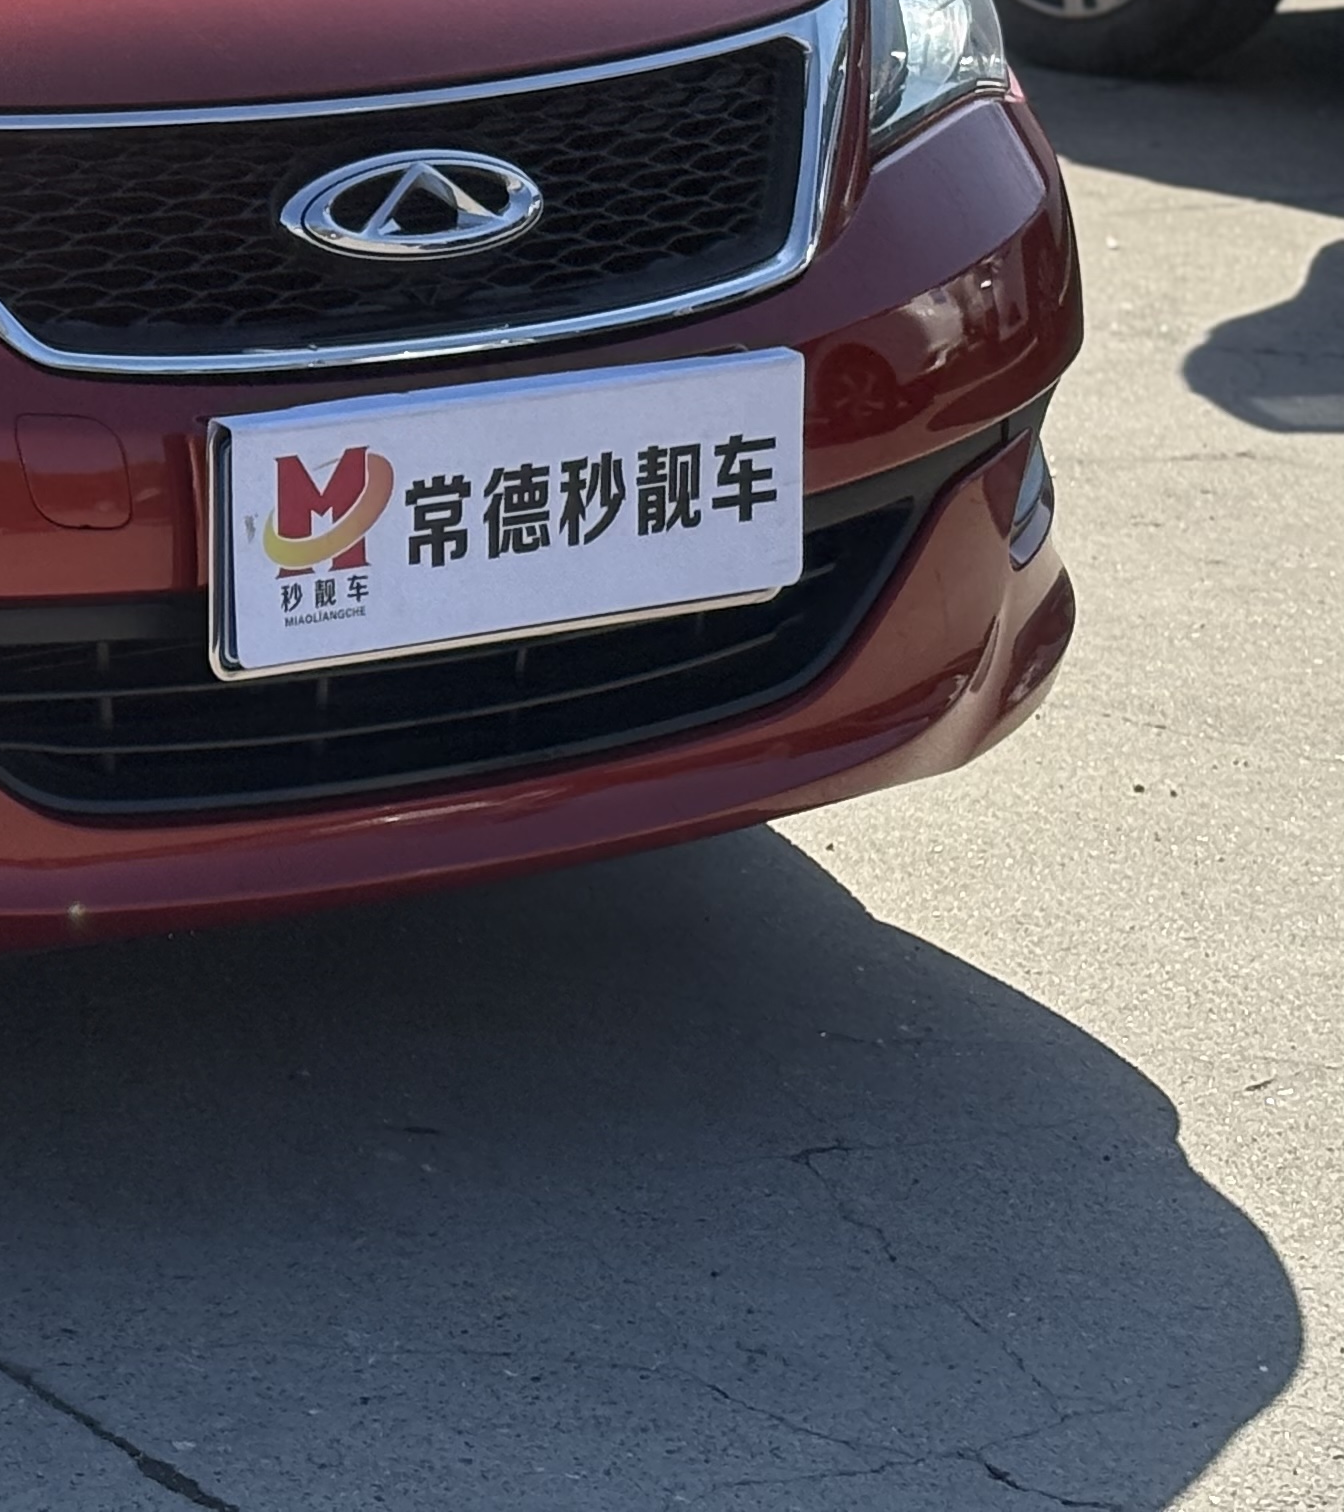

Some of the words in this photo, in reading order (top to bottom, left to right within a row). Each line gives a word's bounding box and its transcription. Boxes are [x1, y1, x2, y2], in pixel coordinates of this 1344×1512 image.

[405, 434, 777, 567] 常德秒靓车
[280, 574, 369, 613] 秒靓车
[284, 605, 367, 628] MIAOLIANGCHE
